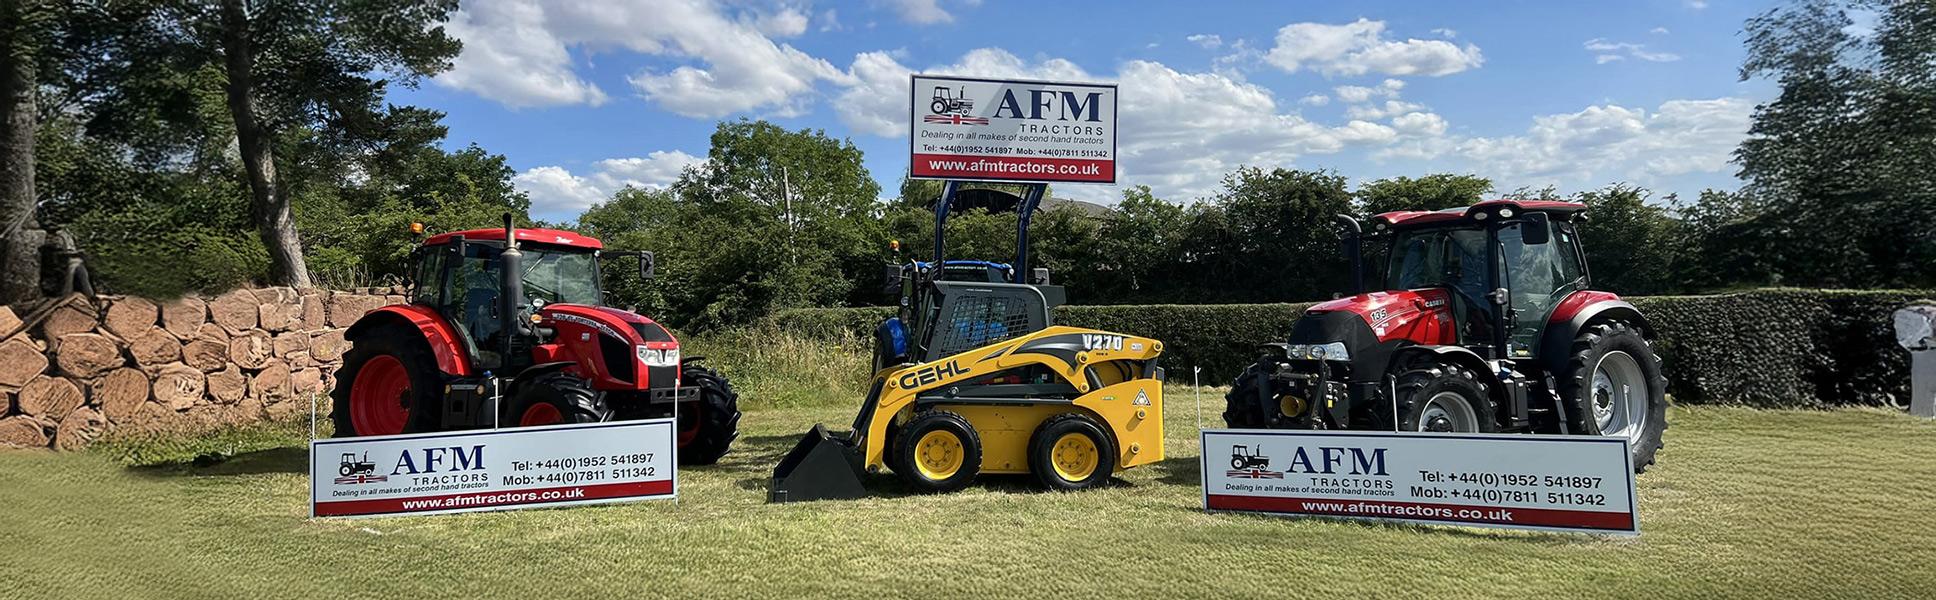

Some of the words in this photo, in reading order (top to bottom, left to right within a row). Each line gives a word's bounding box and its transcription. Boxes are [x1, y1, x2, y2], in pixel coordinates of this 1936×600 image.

[992, 88, 1103, 122] AFM
[921, 130, 954, 141] Dealing
[956, 131, 964, 140] in
[966, 132, 976, 140] all
[978, 132, 1006, 142] makes
[1008, 133, 1018, 142] of
[1019, 134, 1048, 143] second
[1050, 135, 1071, 144] hand
[1073, 136, 1104, 145] tractors
[1020, 124, 1103, 136] TRACTORS
[940, 145, 982, 154] +44(0)1952
[985, 146, 1012, 154] 541897
[1016, 148, 1036, 156] Mob:
[1038, 148, 1078, 157] +44(0)7811
[929, 160, 1100, 175] www.afmtractors.co.uk
[1370, 308, 1387, 321] 135
[1082, 334, 1122, 351] V270
[900, 360, 970, 390] GEHL
[390, 444, 486, 476] AFM
[512, 461, 532, 472] Tel:
[536, 456, 606, 470] +44(0)1952
[611, 453, 654, 466] 541897
[1286, 446, 1390, 476] AFM
[413, 473, 488, 485] TRACTORS
[503, 475, 534, 486] Mob:
[537, 470, 606, 484] +44(0)7811
[612, 467, 655, 478] 511342
[1310, 478, 1394, 489] TRACTORS
[1419, 470, 1445, 482] Tel:
[1449, 472, 1538, 488] +44(0)1952
[1544, 476, 1602, 488] 541897
[332, 488, 358, 497] Dealing
[1226, 484, 1254, 492] Dealing
[1410, 486, 1448, 498] Mob:
[1452, 488, 1538, 504] +44(0)7811
[1548, 492, 1606, 506] 511342
[402, 488, 584, 509] www.afmtractors.co.uk
[1302, 502, 1513, 521] www.afmtractors.co.uk
